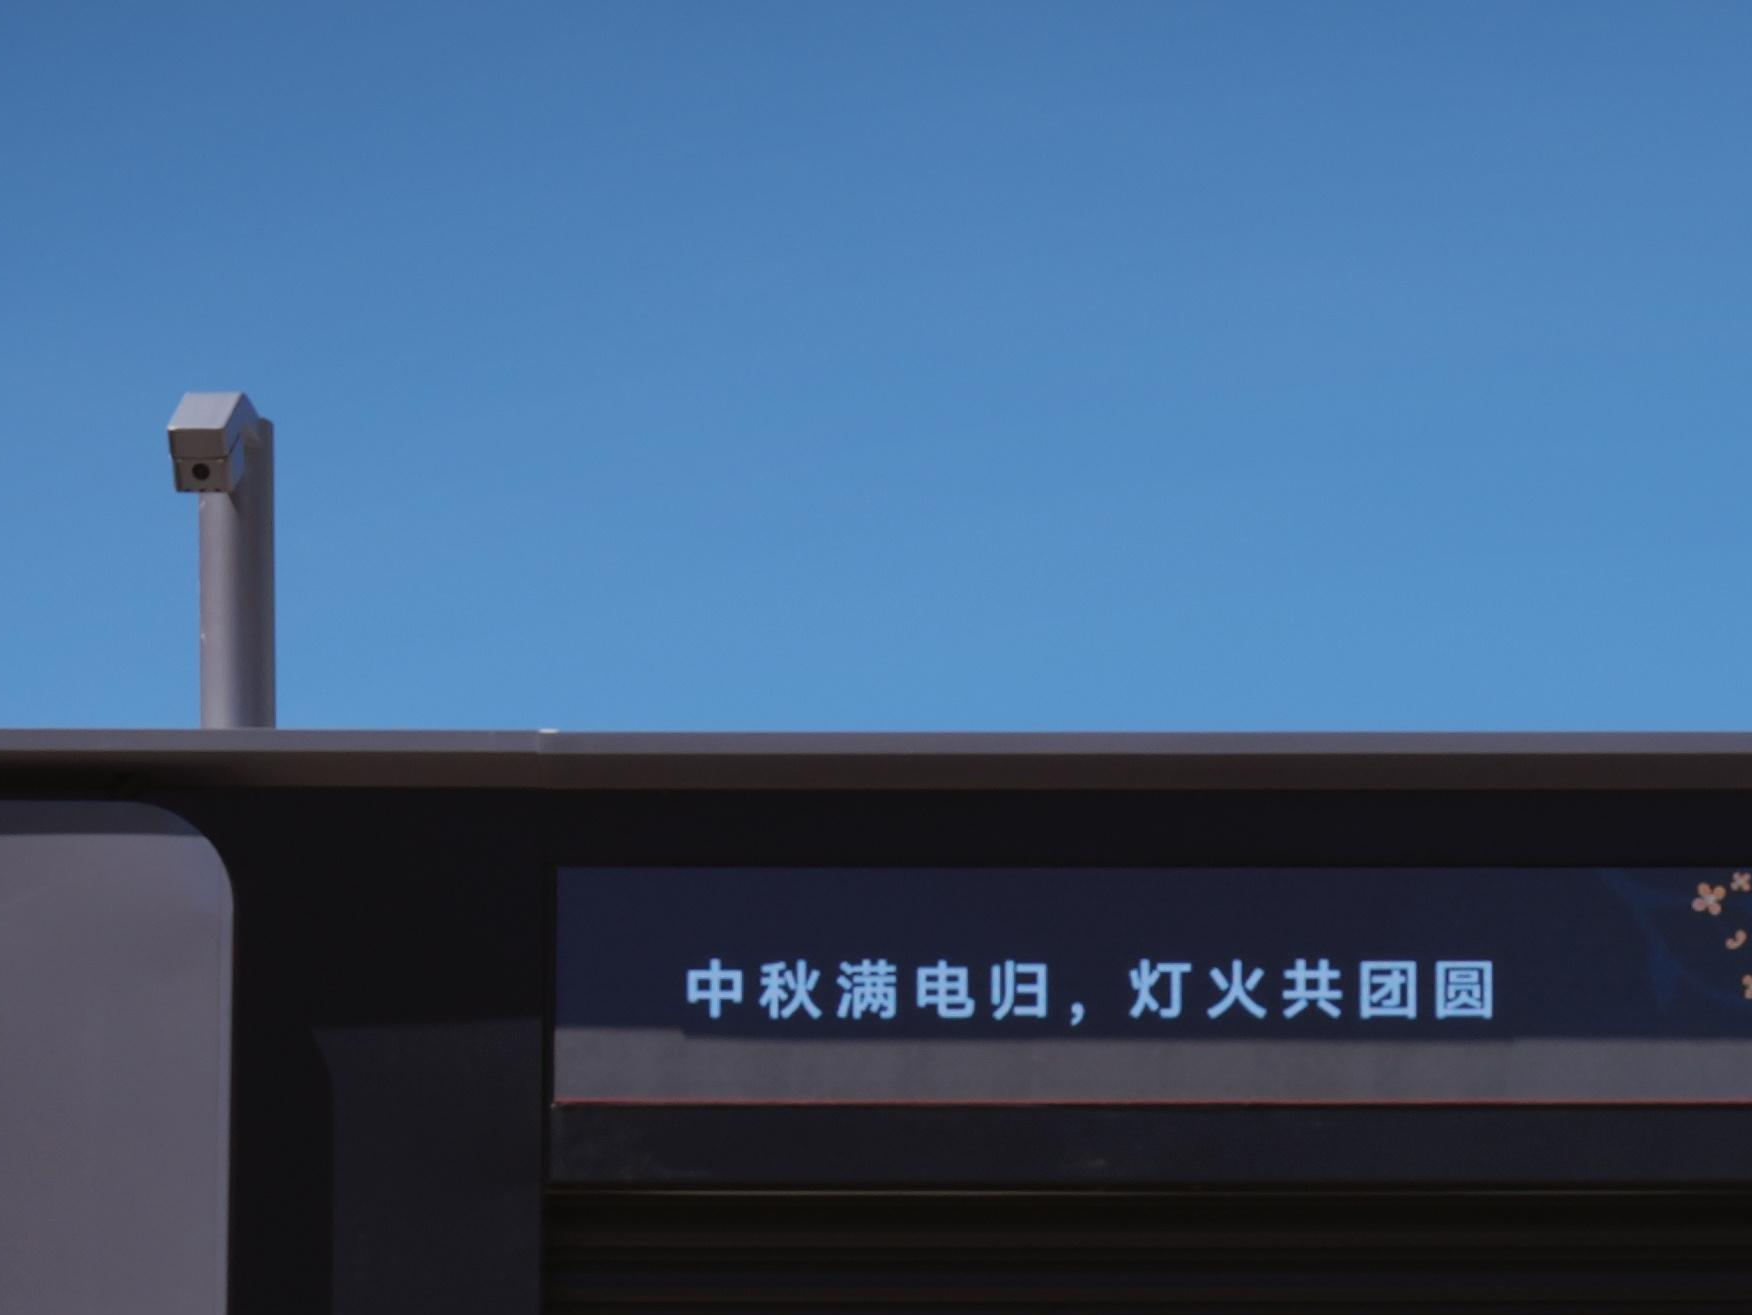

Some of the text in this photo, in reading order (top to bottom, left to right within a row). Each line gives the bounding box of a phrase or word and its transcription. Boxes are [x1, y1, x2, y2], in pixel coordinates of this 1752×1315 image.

[686, 958, 1494, 1026] 中秋满电归，灯火共团圆
